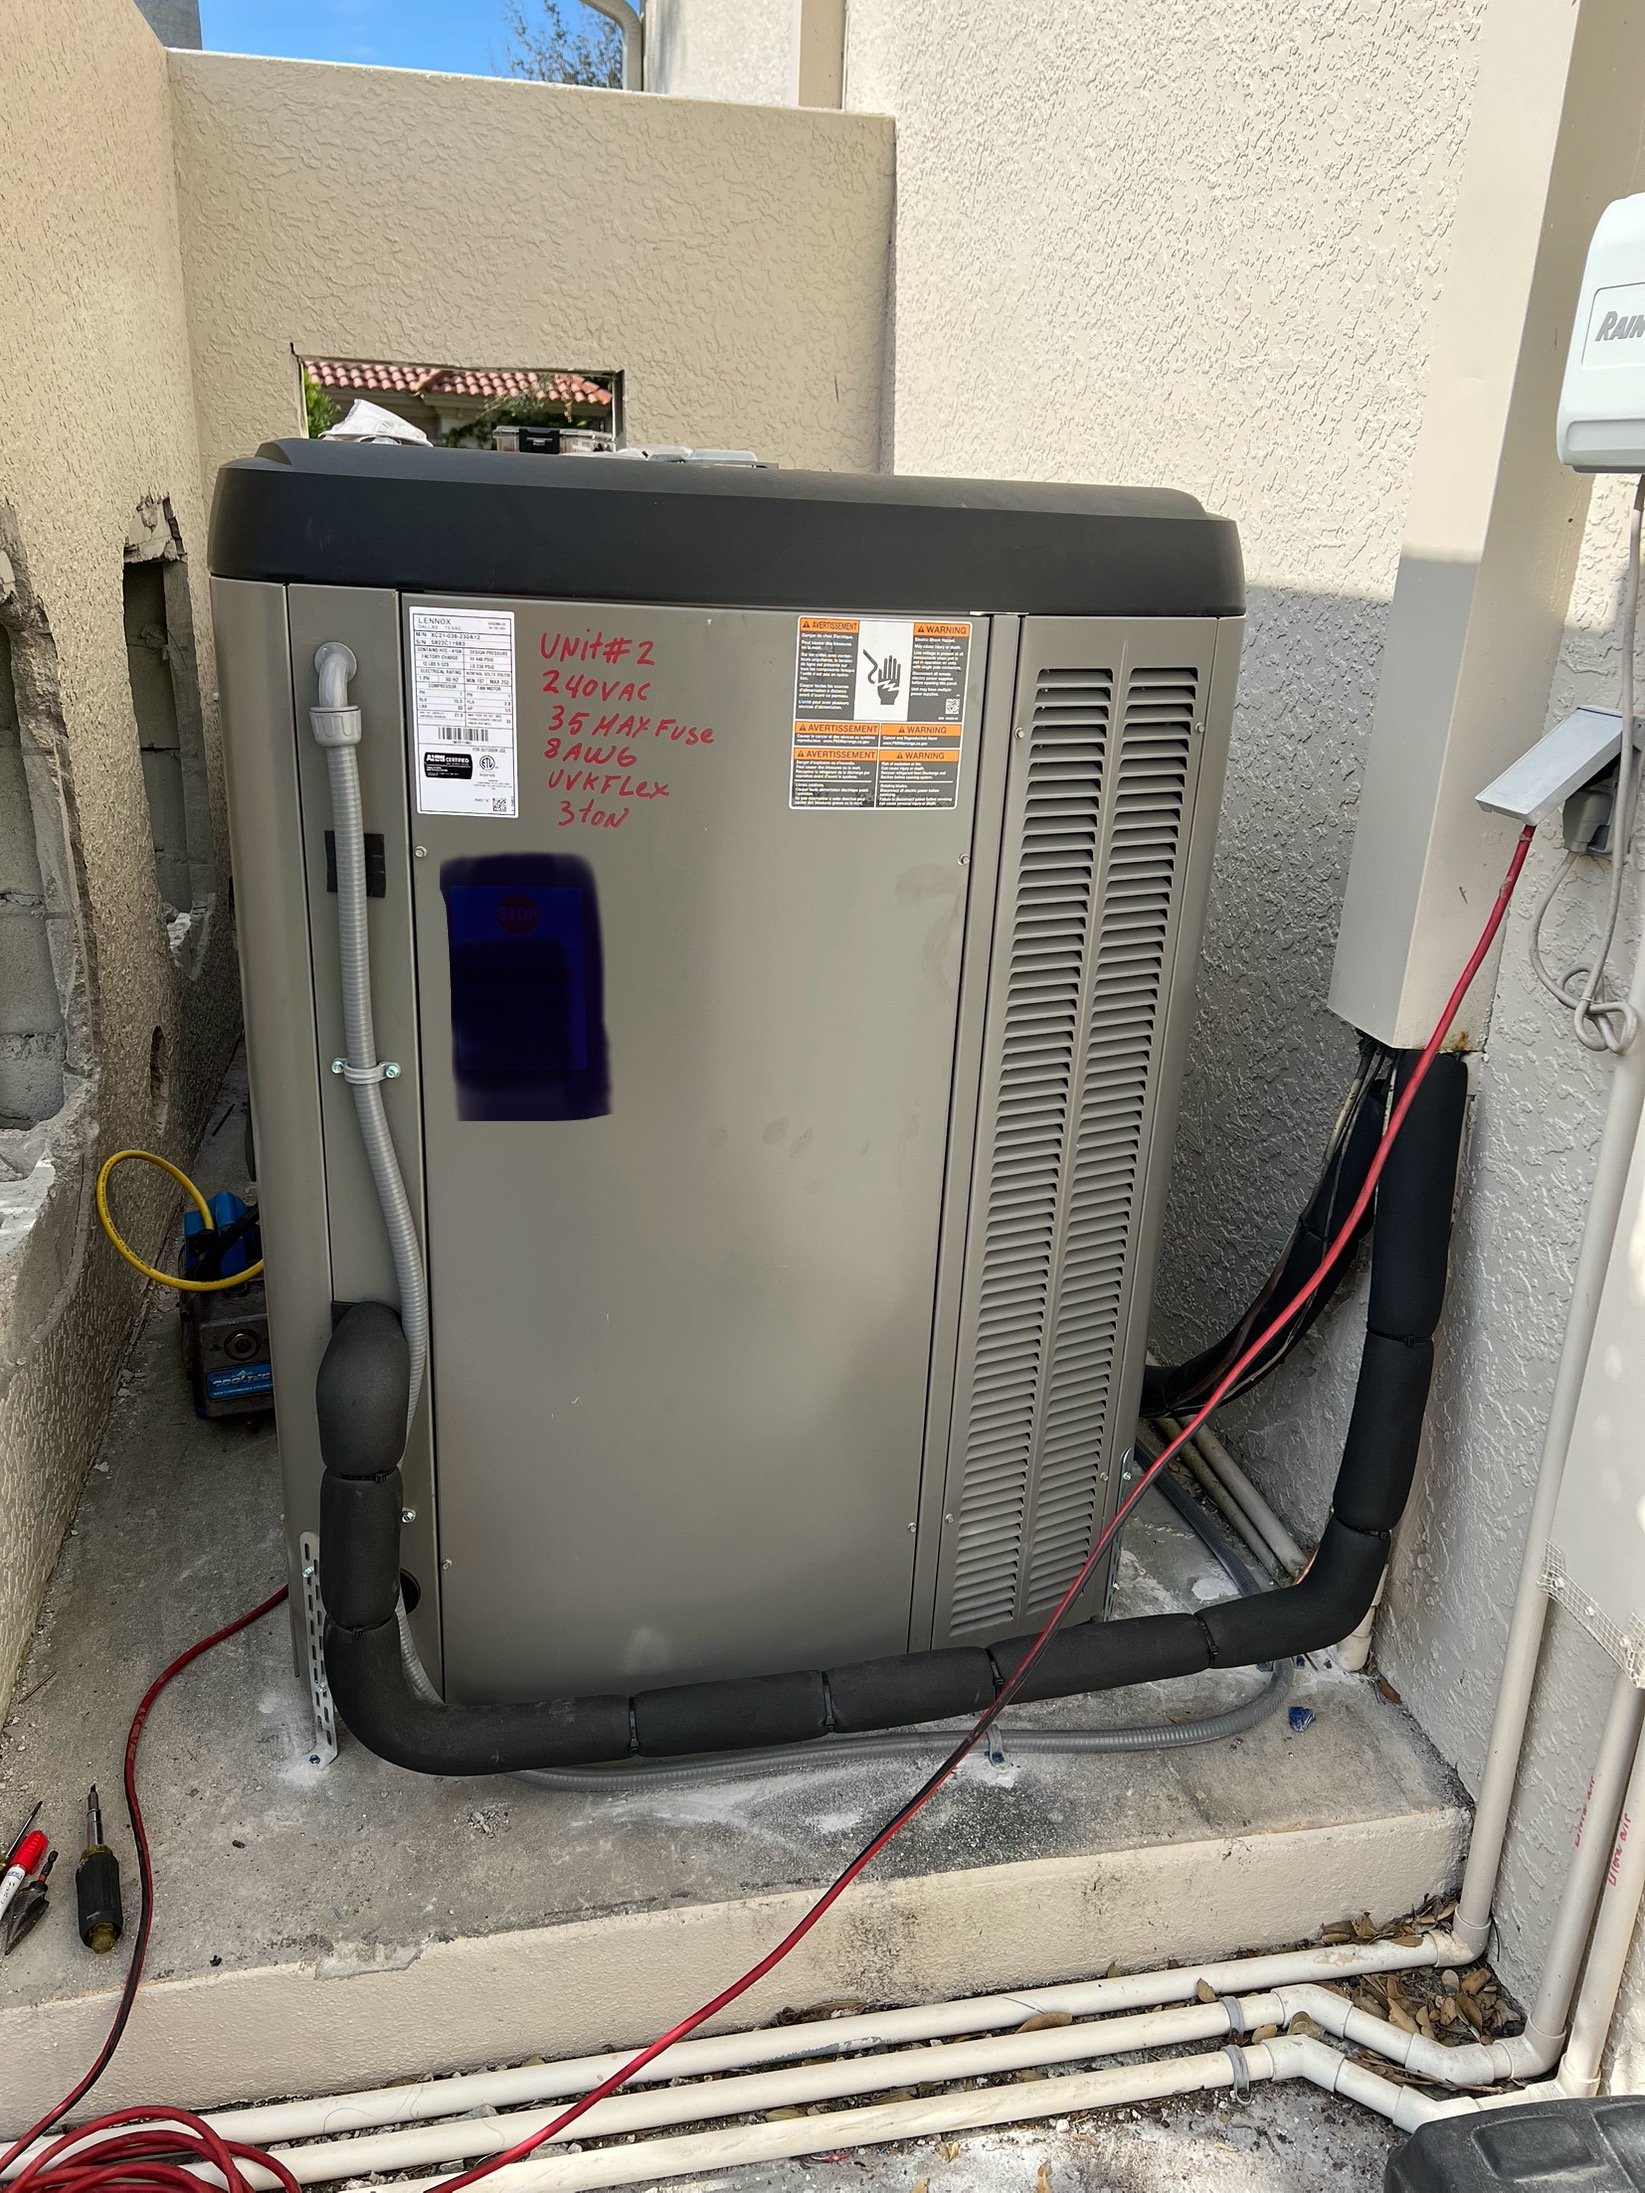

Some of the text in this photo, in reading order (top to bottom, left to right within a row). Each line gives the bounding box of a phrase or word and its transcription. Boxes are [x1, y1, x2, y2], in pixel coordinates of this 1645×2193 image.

[1595, 311, 1645, 341] RAIN
[812, 622, 857, 630] AVERTISSEMENT
[926, 626, 966, 634] WARNING
[548, 705, 590, 736] 35
[808, 724, 878, 732] AVERTISSEMENT
[806, 750, 875, 758] AVERTISSEMENT
